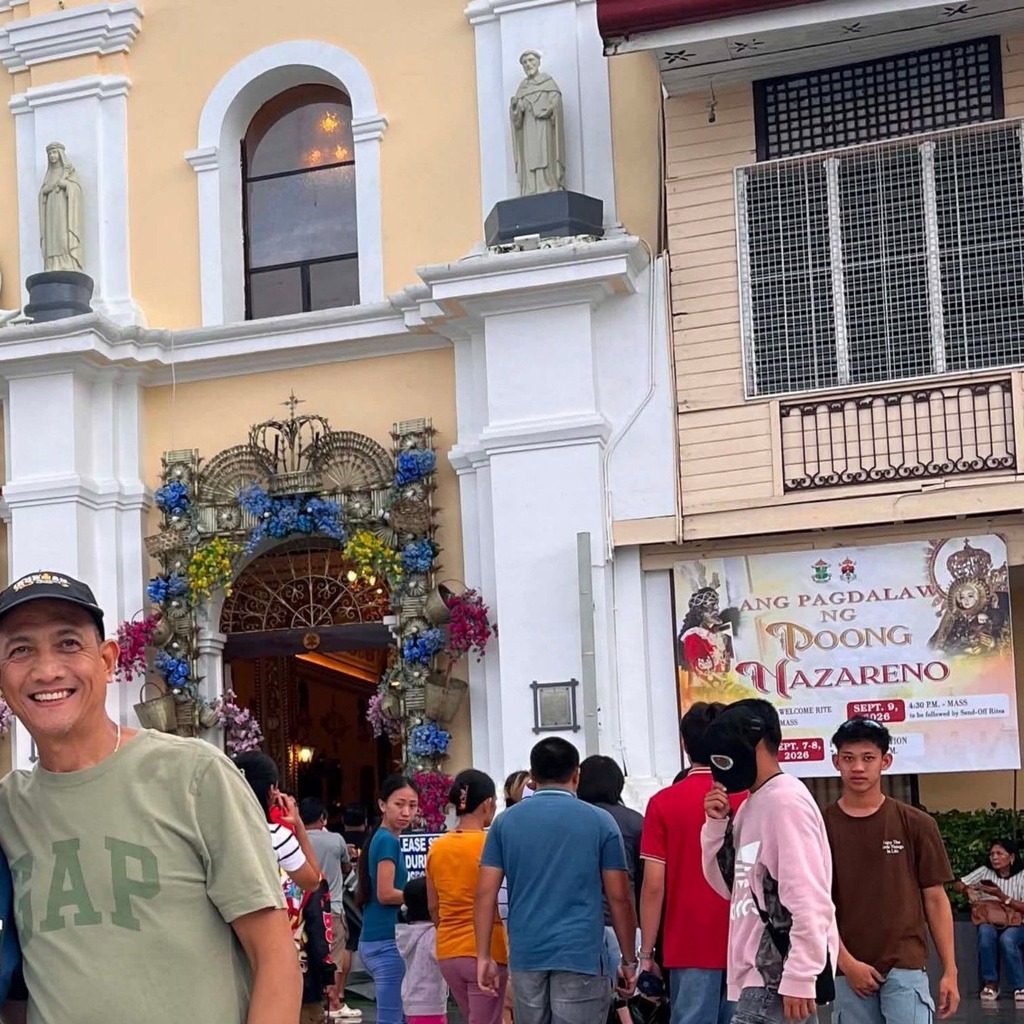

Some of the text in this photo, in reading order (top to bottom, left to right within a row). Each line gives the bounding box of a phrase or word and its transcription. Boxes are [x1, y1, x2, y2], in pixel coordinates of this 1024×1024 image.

[740, 585, 941, 612] ANG PAGDALAW
[821, 608, 857, 623] NG
[765, 621, 912, 662] POONG
[735, 658, 950, 699] NAZARENO
[853, 702, 899, 713] SEPT. 9,
[909, 702, 925, 710] 4:30
[947, 699, 968, 707] MASS
[779, 707, 815, 716] WELCOME
[951, 710, 959, 718] by
[779, 719, 799, 727] MASS
[778, 742, 799, 751] EPT.
[802, 741, 822, 751] 7-8,
[784, 751, 810, 760] 2026
